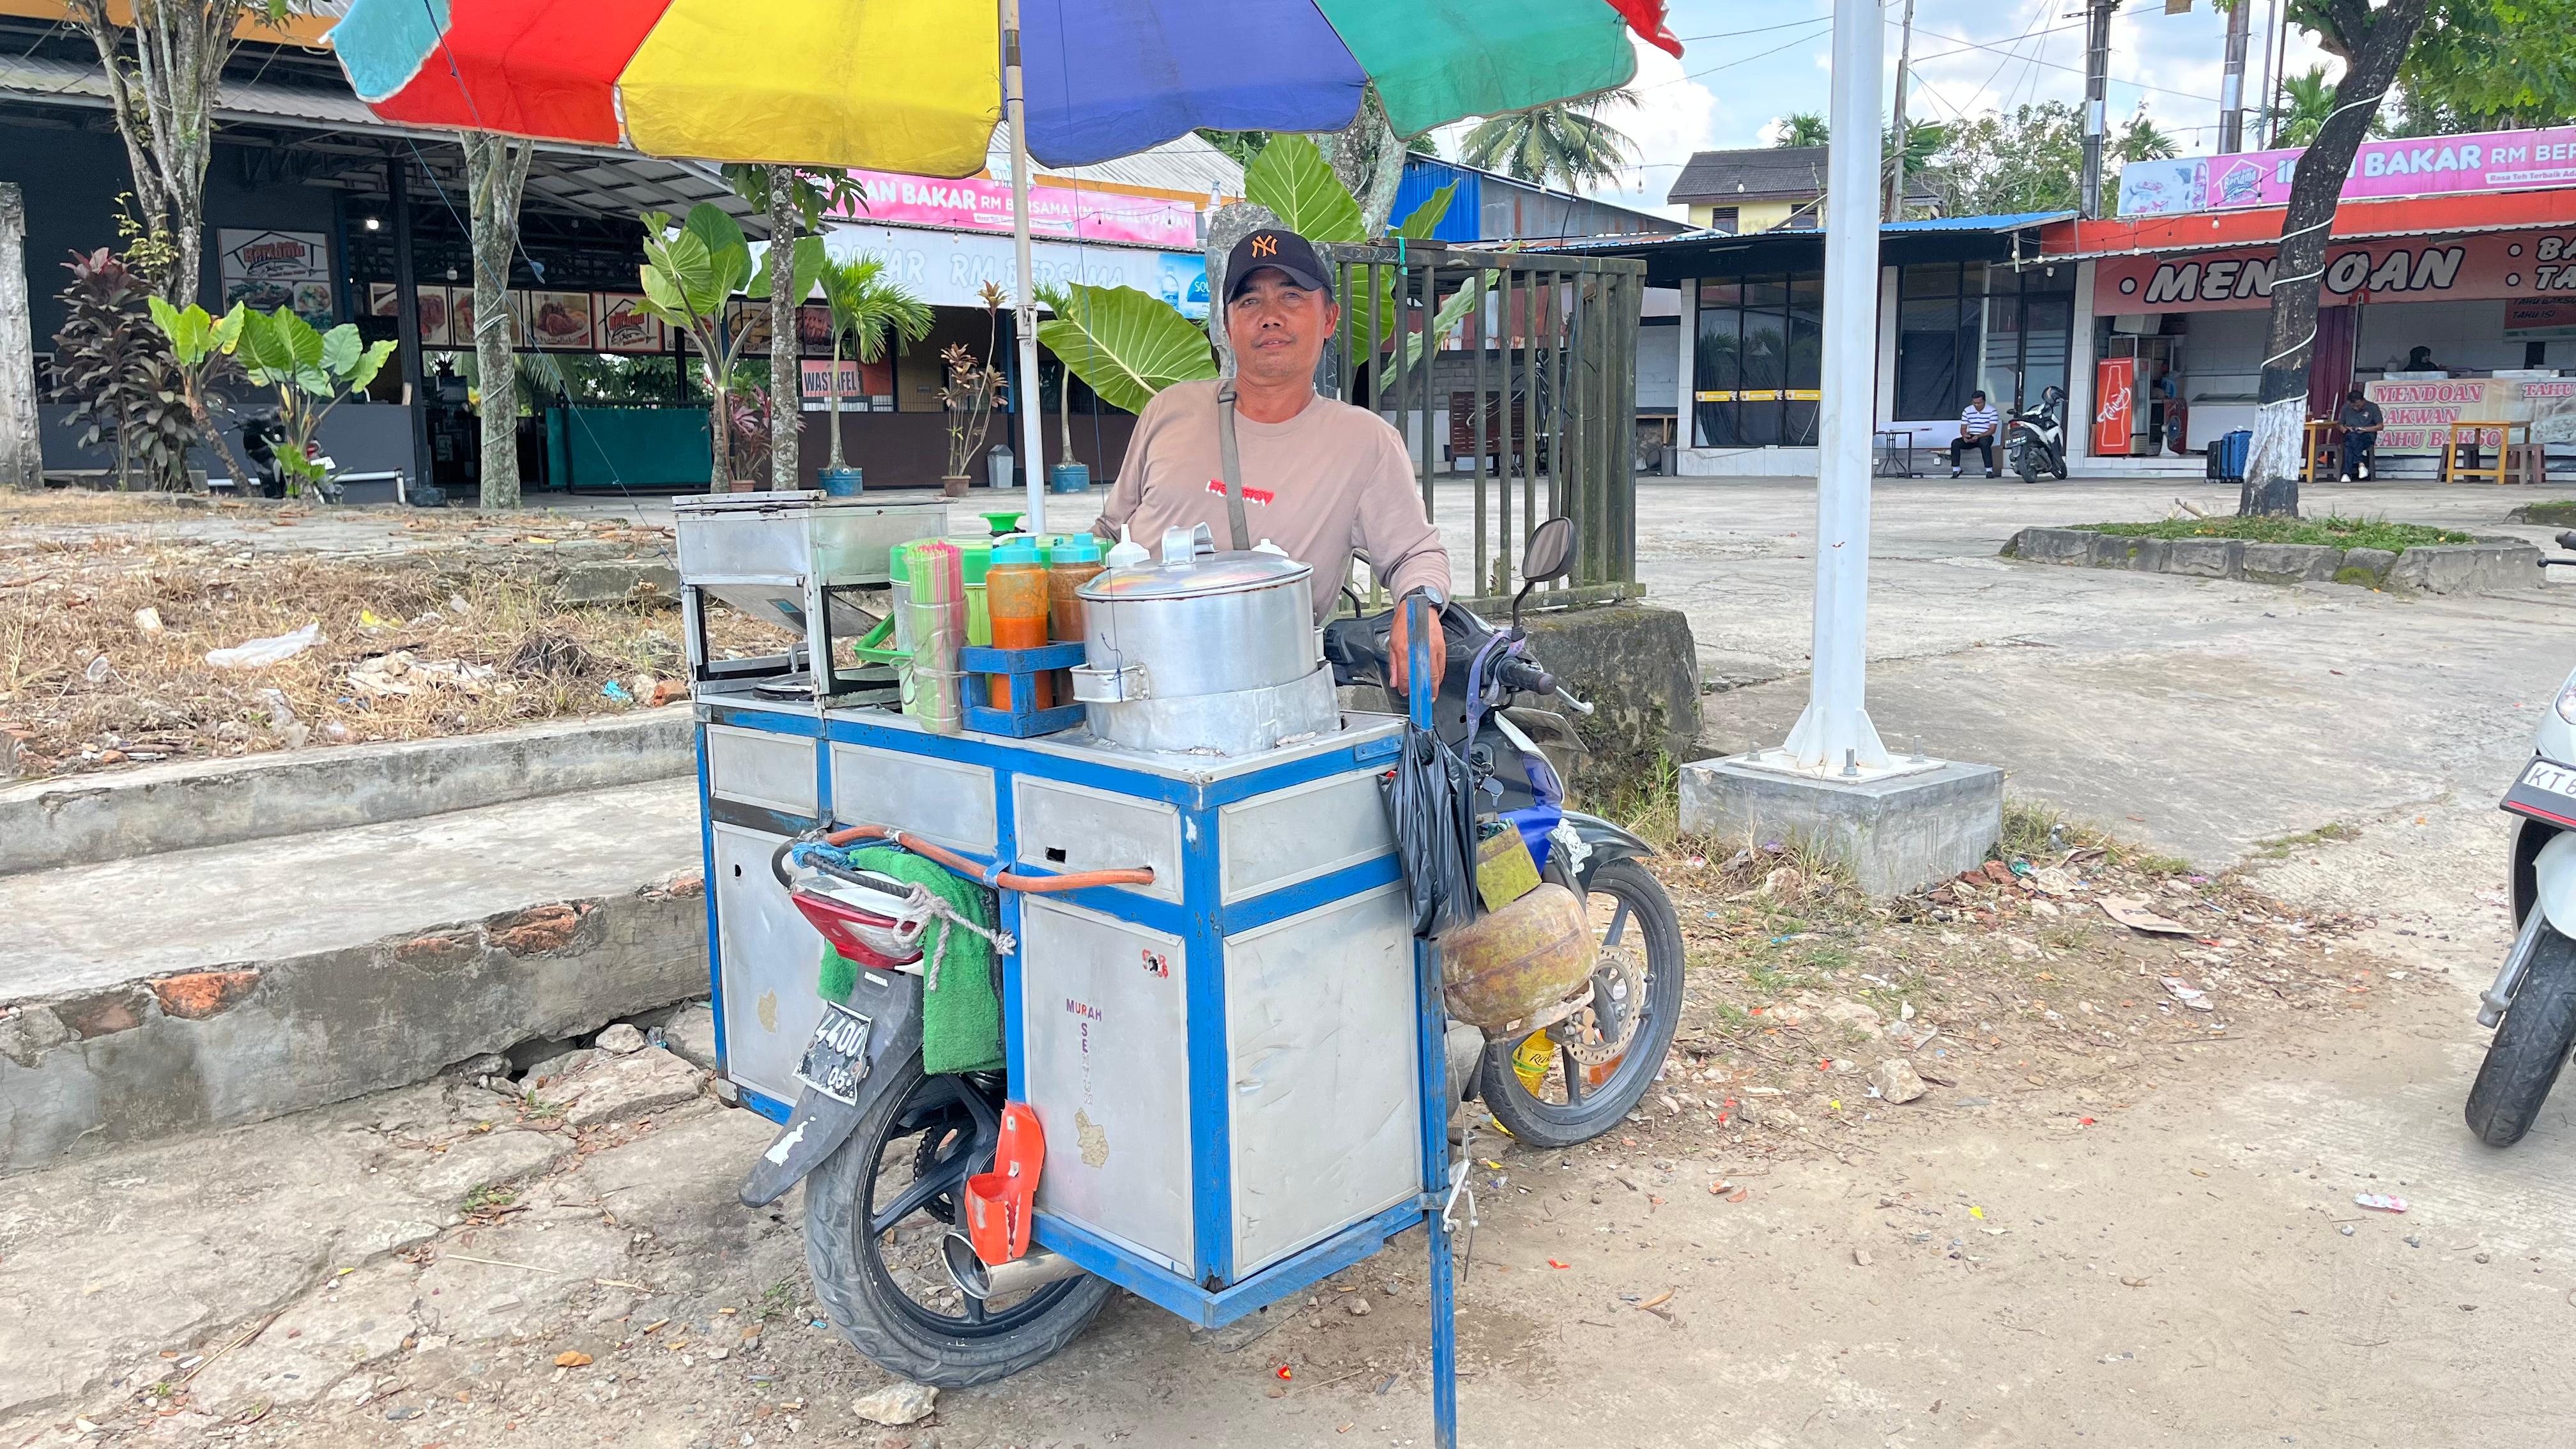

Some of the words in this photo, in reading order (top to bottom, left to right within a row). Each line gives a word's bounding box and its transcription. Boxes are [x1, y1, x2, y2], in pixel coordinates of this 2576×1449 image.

[2365, 144, 2482, 178] BAKAR
[2490, 146, 2527, 164] RM
[2530, 171, 2561, 180] Terbaik
[901, 182, 977, 210] BAKAR
[981, 195, 1001, 210] RM
[1006, 198, 1070, 218] BRSAMA
[950, 253, 995, 288] RM
[2143, 245, 2465, 303] MENOAN
[2374, 383, 2484, 403] MENDOAN
[2524, 383, 2575, 399] TAHU
[2527, 767, 2566, 790] KT
[1066, 998, 1102, 1022] MURAH
